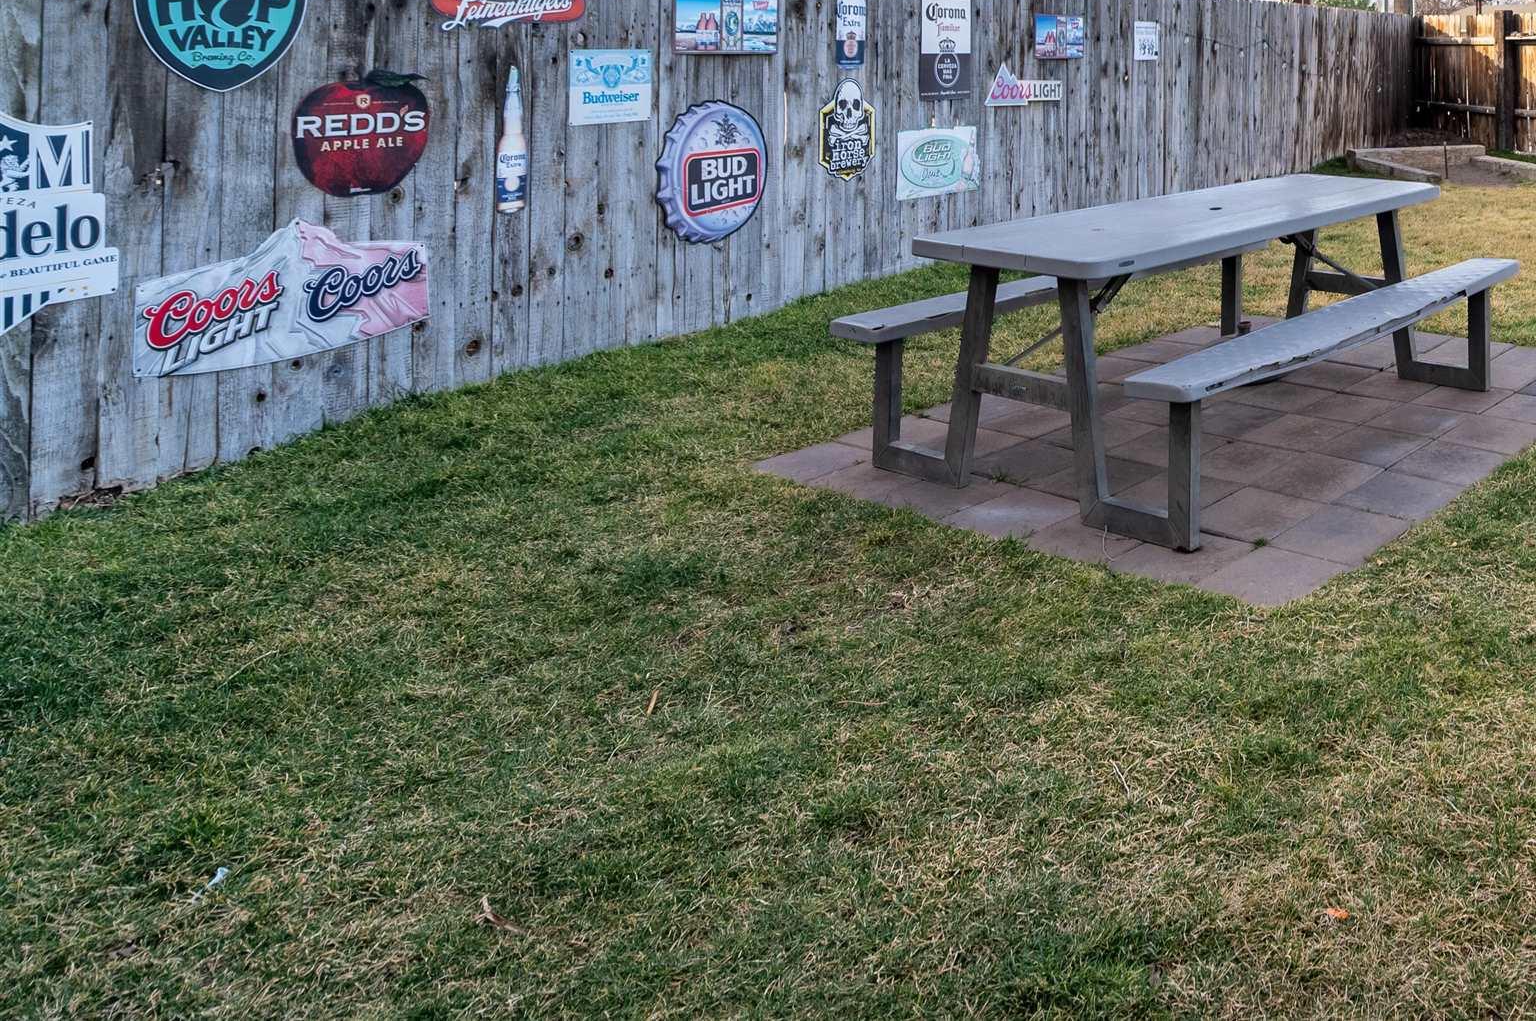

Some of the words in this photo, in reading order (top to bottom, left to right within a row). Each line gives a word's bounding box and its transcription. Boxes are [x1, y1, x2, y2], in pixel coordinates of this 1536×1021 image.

[926, 2, 966, 23] Corona
[168, 25, 276, 52] VALLEY
[192, 51, 236, 65] Brewing
[237, 51, 255, 62] Co.
[583, 90, 640, 105] Budweiser
[991, 75, 1032, 100] Coors
[1033, 83, 1062, 98] LIGHT
[295, 105, 426, 139] REDD'S
[320, 138, 370, 152] APPLE
[376, 136, 404, 148] ALE
[835, 139, 862, 151] iron
[923, 143, 952, 153] BUD
[831, 157, 868, 170] brewery
[832, 148, 866, 162] horse
[918, 152, 952, 163] LIGHT
[701, 156, 748, 181] BUD
[691, 175, 756, 206] LIGHT
[0, 196, 37, 209] EZA
[10, 261, 81, 278] BEAUTIFUL
[83, 254, 118, 267] GAME
[304, 248, 424, 323] Coors
[143, 270, 285, 349] Coors
[158, 301, 279, 378] LIGHT
